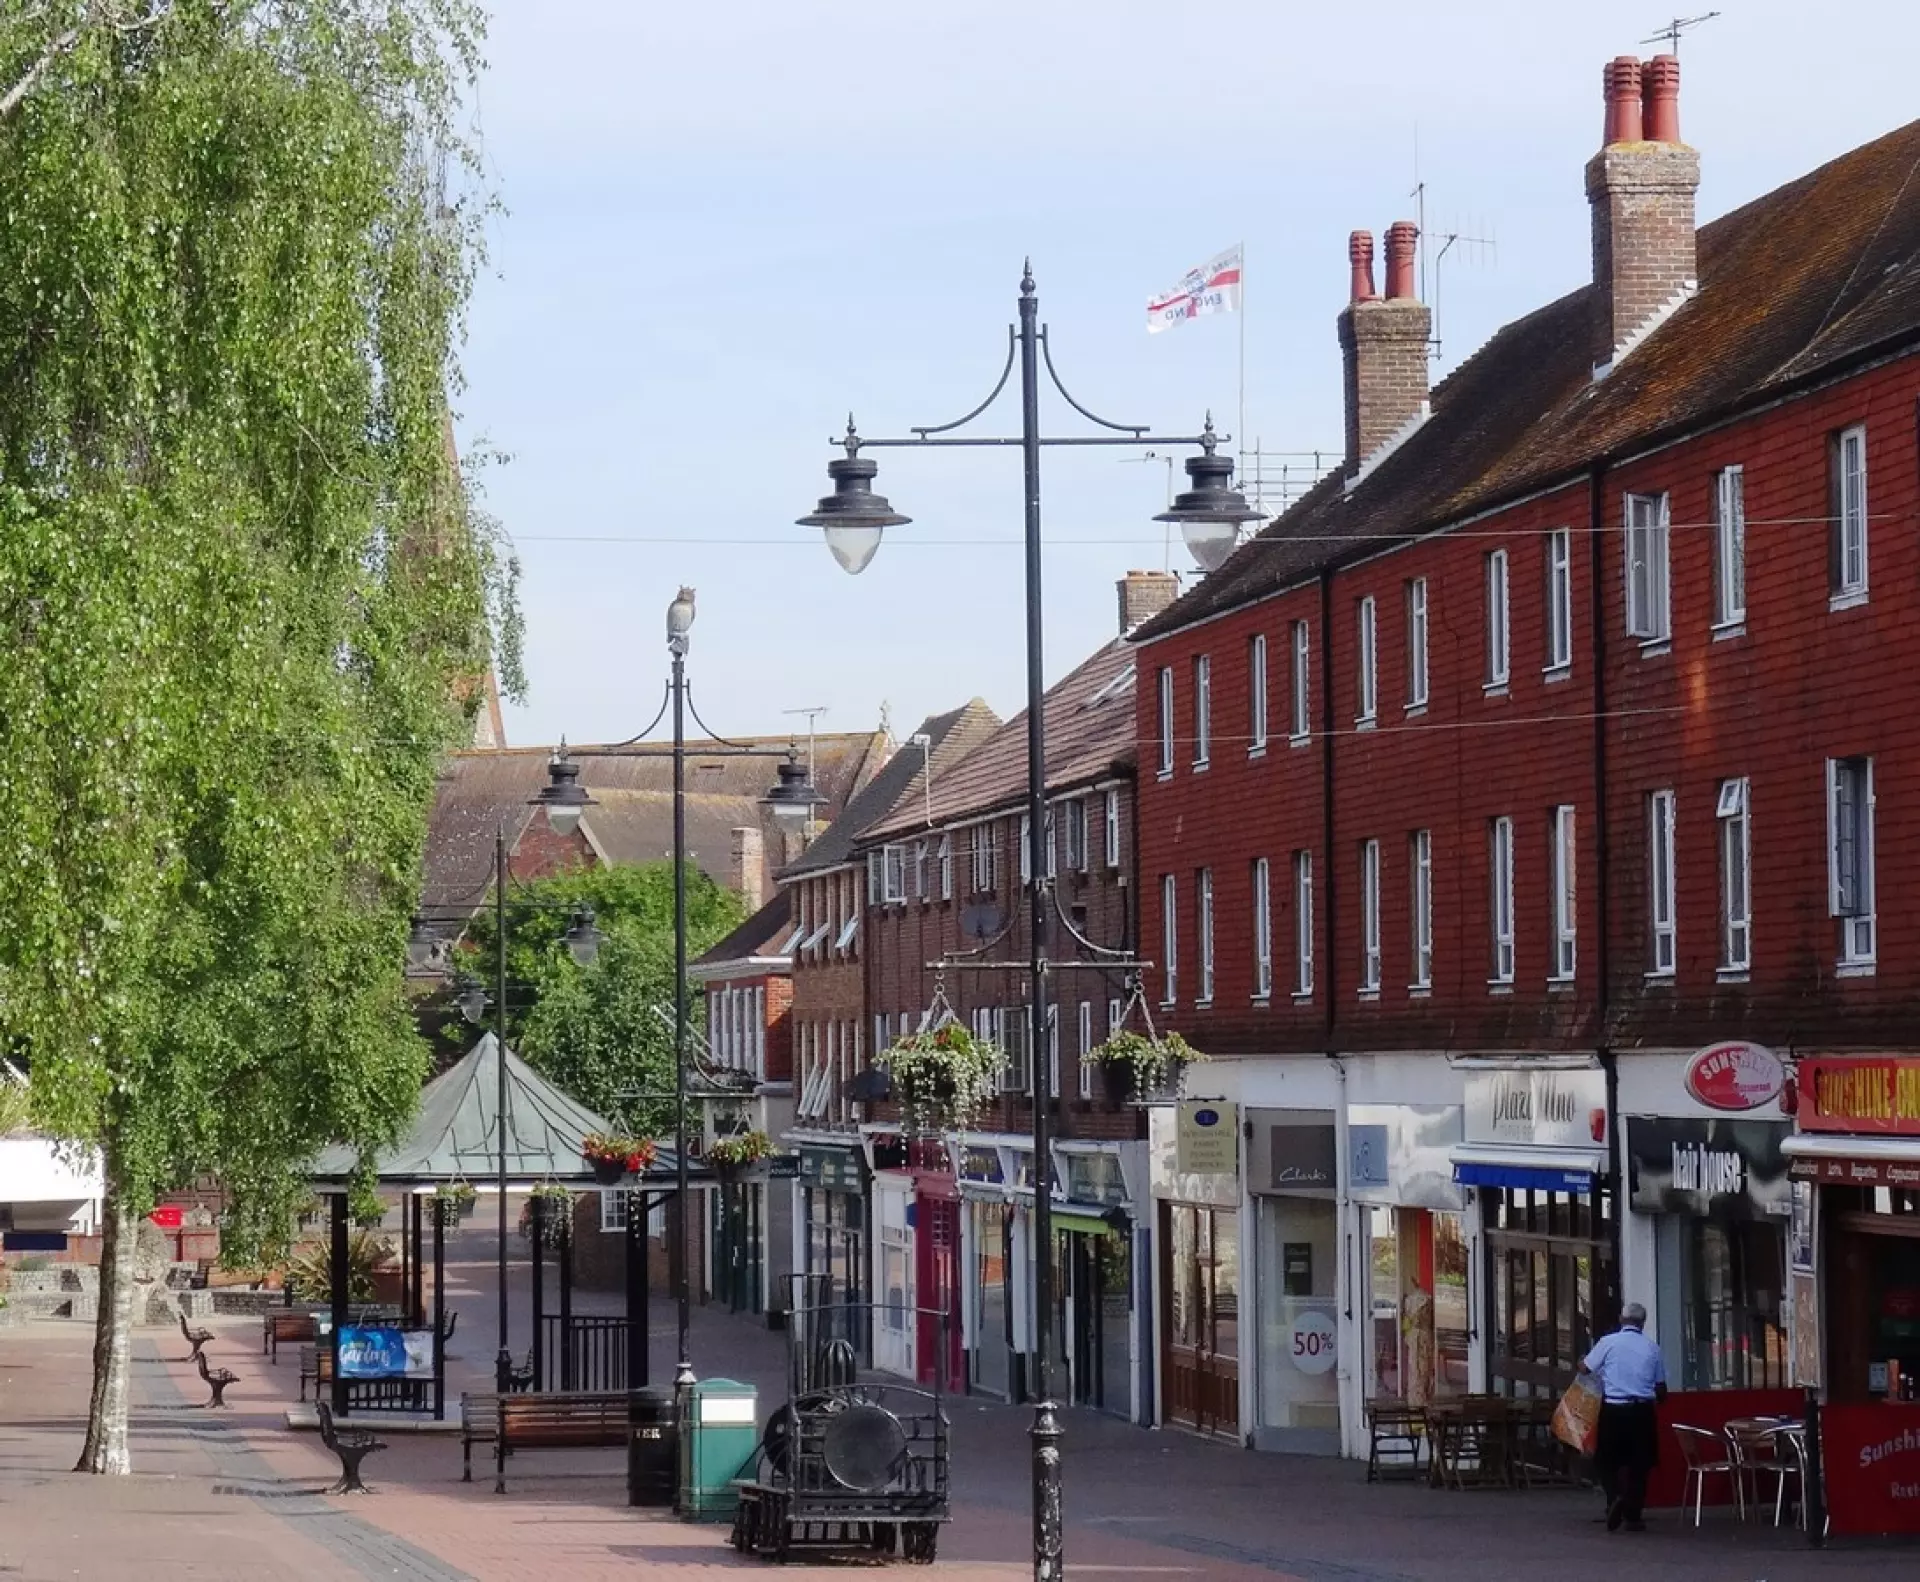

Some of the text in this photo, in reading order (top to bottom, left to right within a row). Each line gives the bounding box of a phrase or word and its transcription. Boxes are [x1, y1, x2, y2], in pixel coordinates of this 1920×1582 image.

[1672, 1141, 1741, 1194] hair house
[1293, 1331, 1334, 1356] 50%
